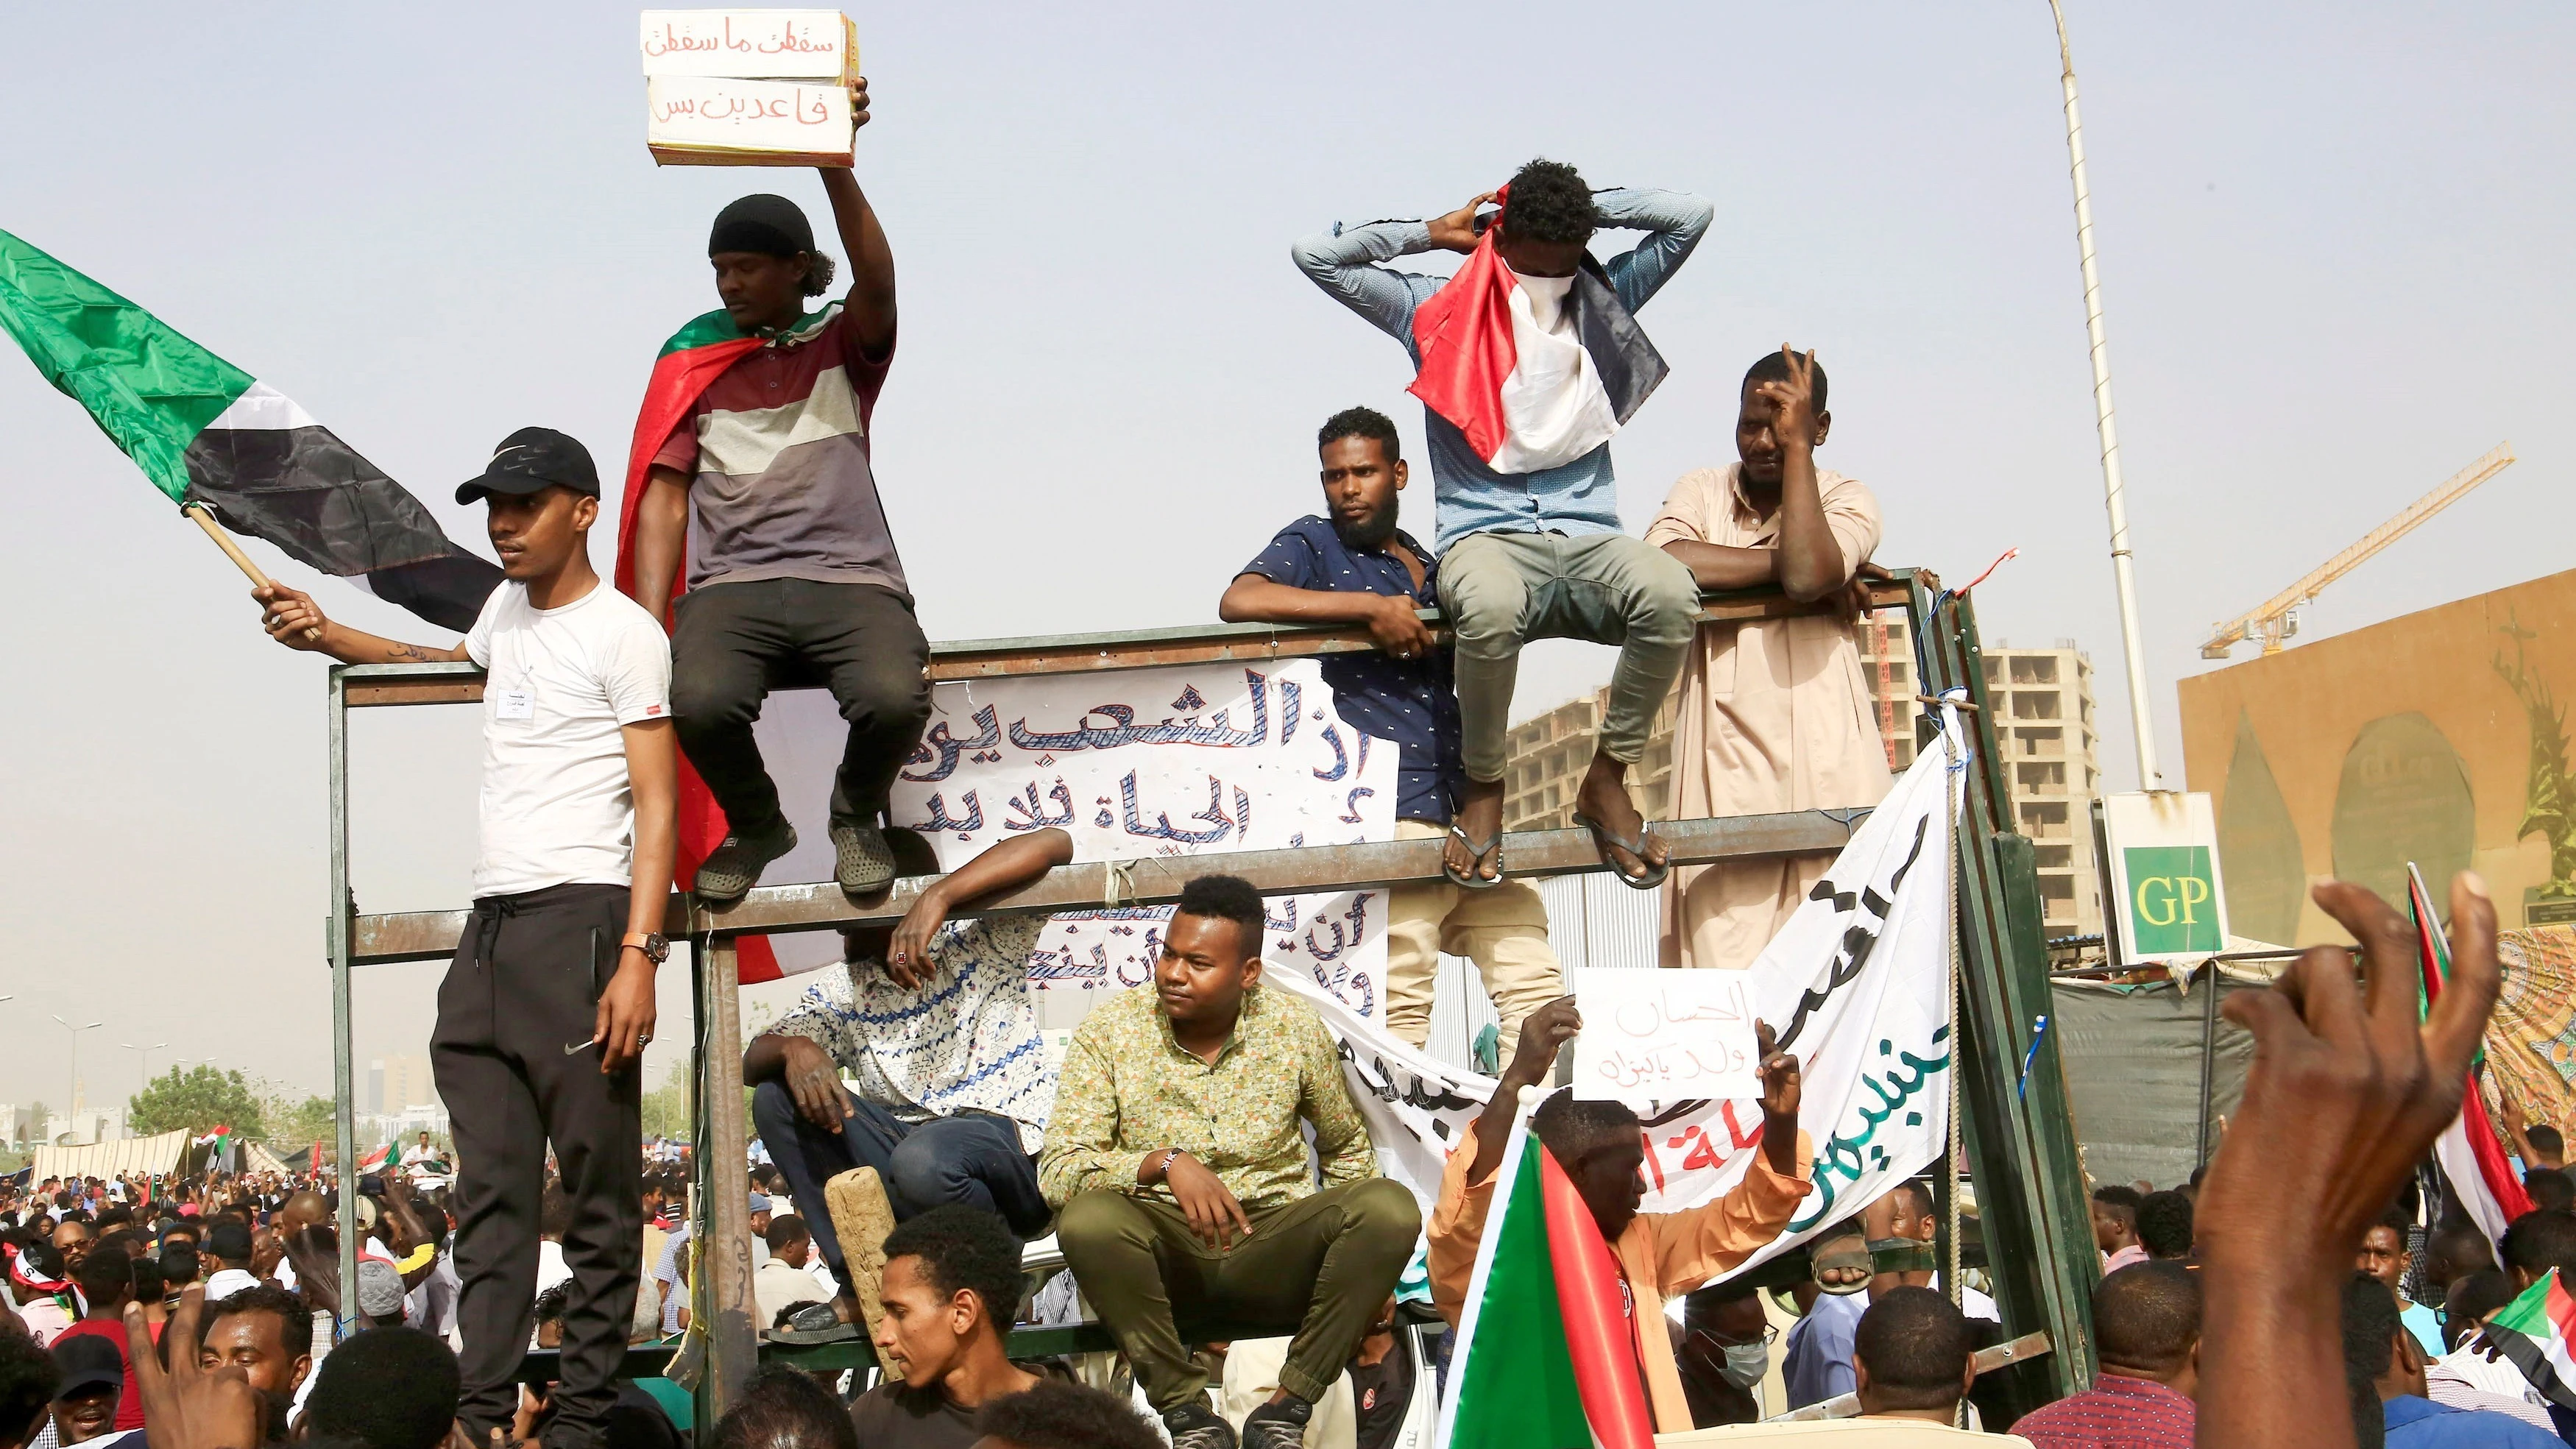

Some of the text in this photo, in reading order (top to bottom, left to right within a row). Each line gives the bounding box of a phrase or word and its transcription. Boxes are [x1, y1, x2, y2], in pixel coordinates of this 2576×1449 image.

[725, 16, 751, 53] ما
[1094, 768, 1250, 857] الحياة
[2137, 876, 2209, 927] GP
